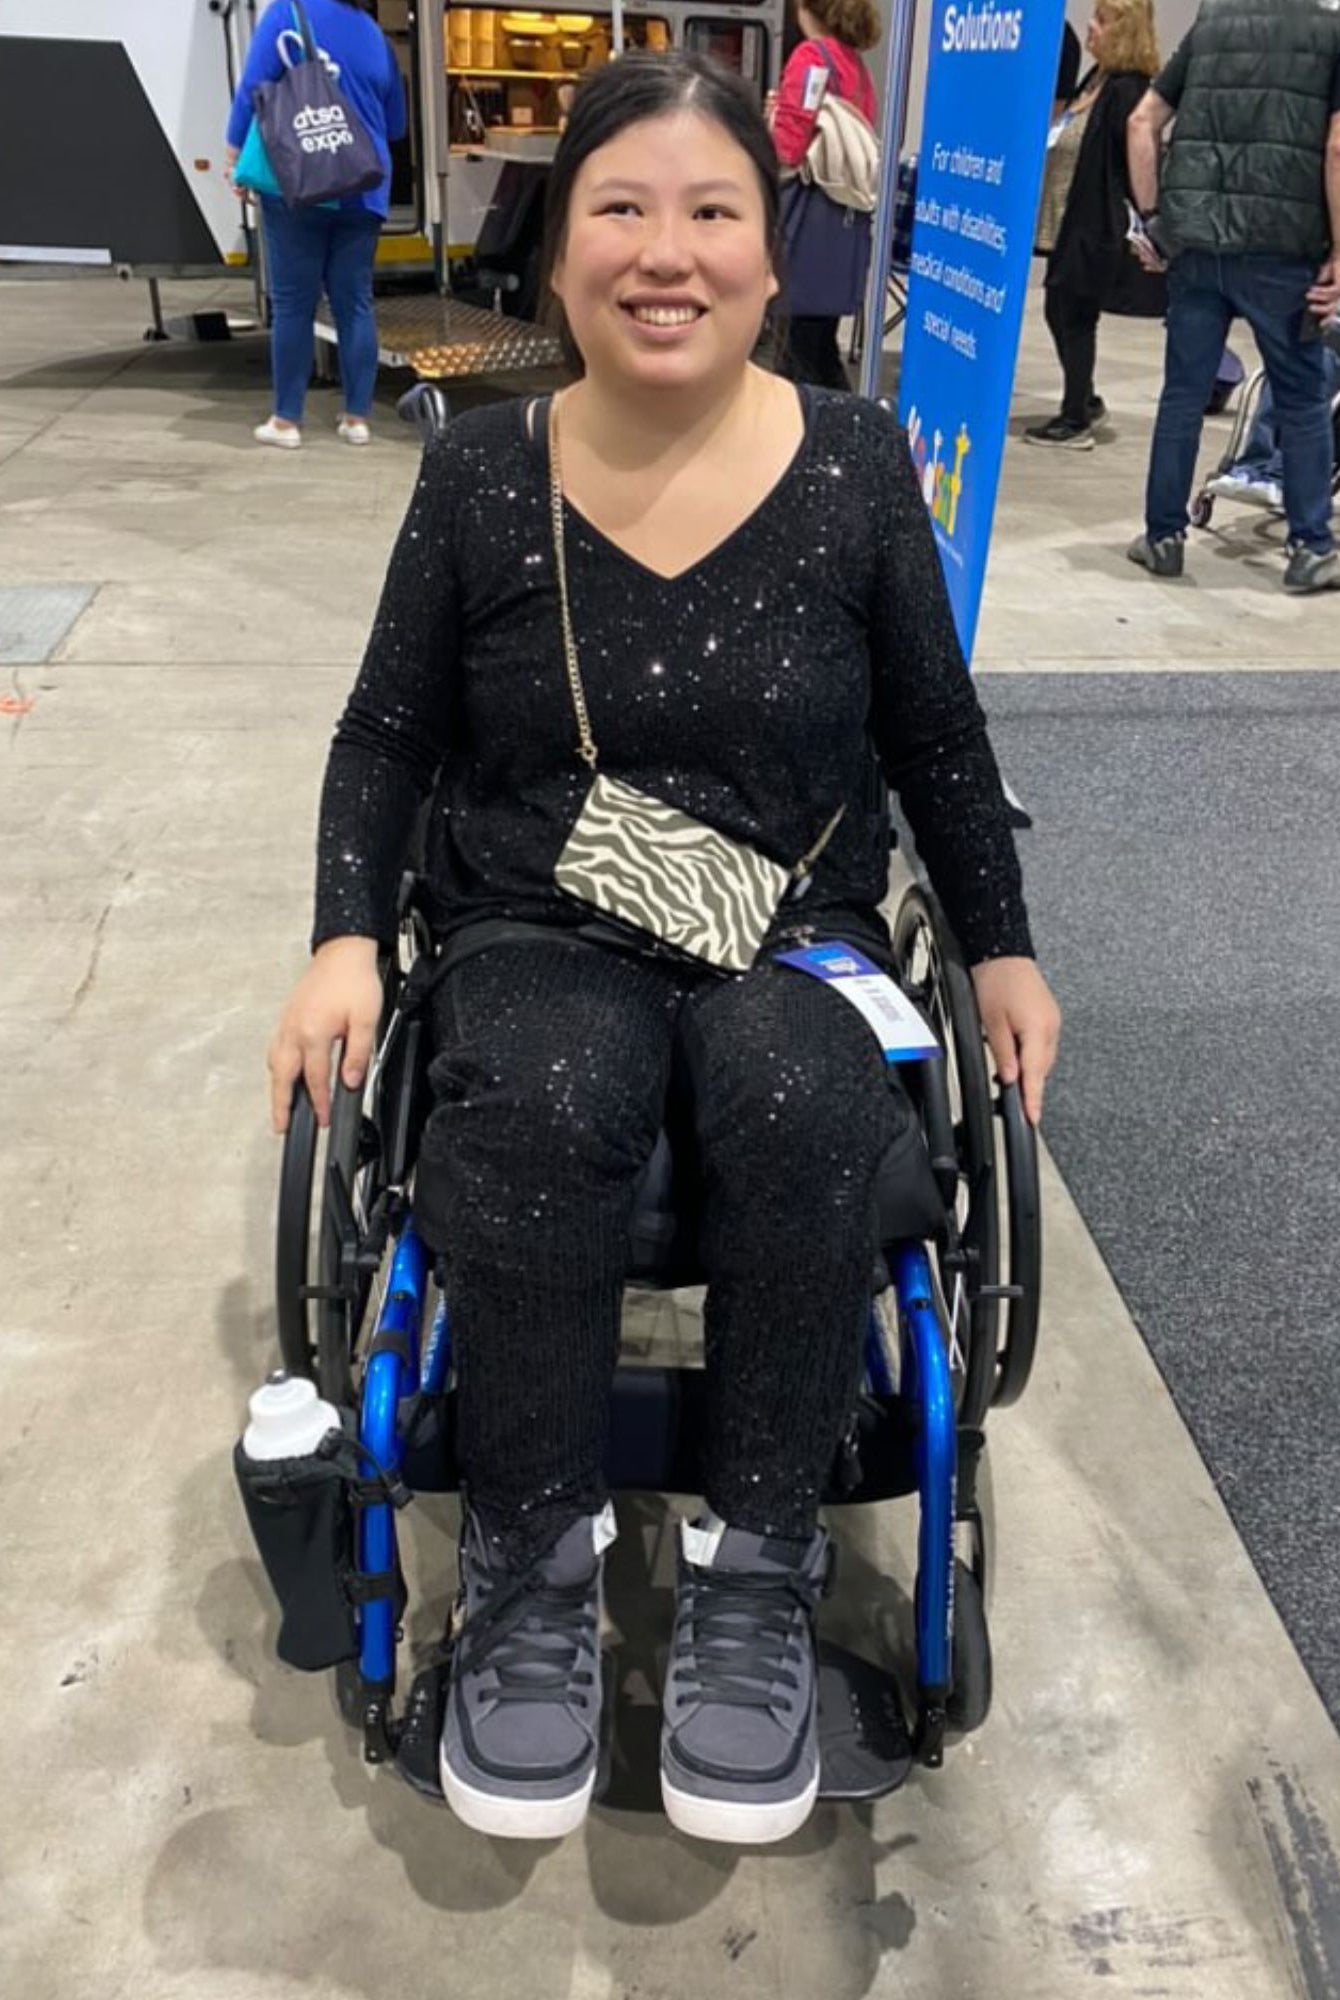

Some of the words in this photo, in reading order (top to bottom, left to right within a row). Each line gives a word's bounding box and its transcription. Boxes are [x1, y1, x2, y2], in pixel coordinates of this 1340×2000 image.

[942, 1, 1022, 51] Solutions
[293, 104, 345, 130] atsa
[301, 130, 353, 154] expo
[932, 143, 949, 171] For
[950, 146, 984, 179] children
[985, 156, 1005, 185] and
[942, 204, 959, 231] with
[911, 252, 943, 281] medical
[944, 265, 984, 303] conditions
[985, 285, 1006, 313] and
[924, 311, 951, 342] special
